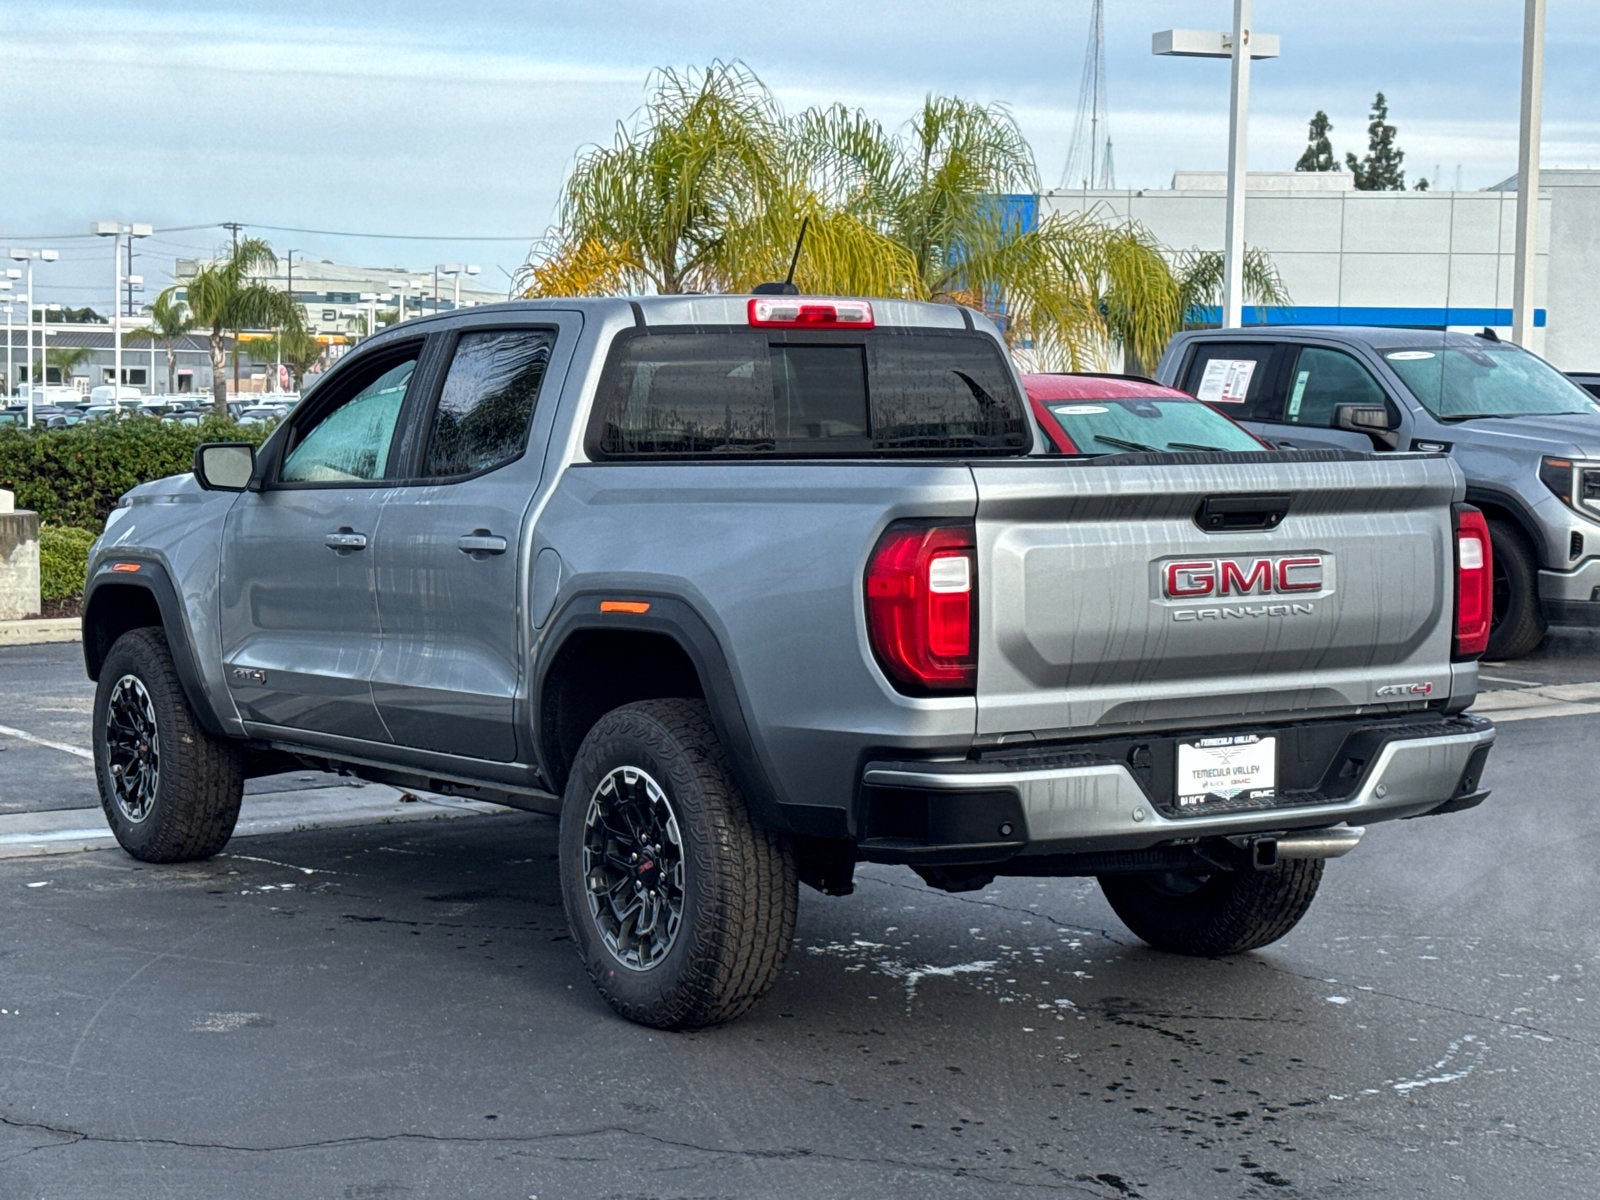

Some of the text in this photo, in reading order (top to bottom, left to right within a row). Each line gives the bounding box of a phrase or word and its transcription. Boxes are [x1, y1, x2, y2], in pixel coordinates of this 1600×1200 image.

[1164, 556, 1322, 599] GMC
[1173, 603, 1314, 622] CANYON
[1376, 681, 1433, 697] AT4
[1192, 765, 1260, 779] TEMECULA VALLEY
[1180, 790, 1274, 806] BUICK GMC
